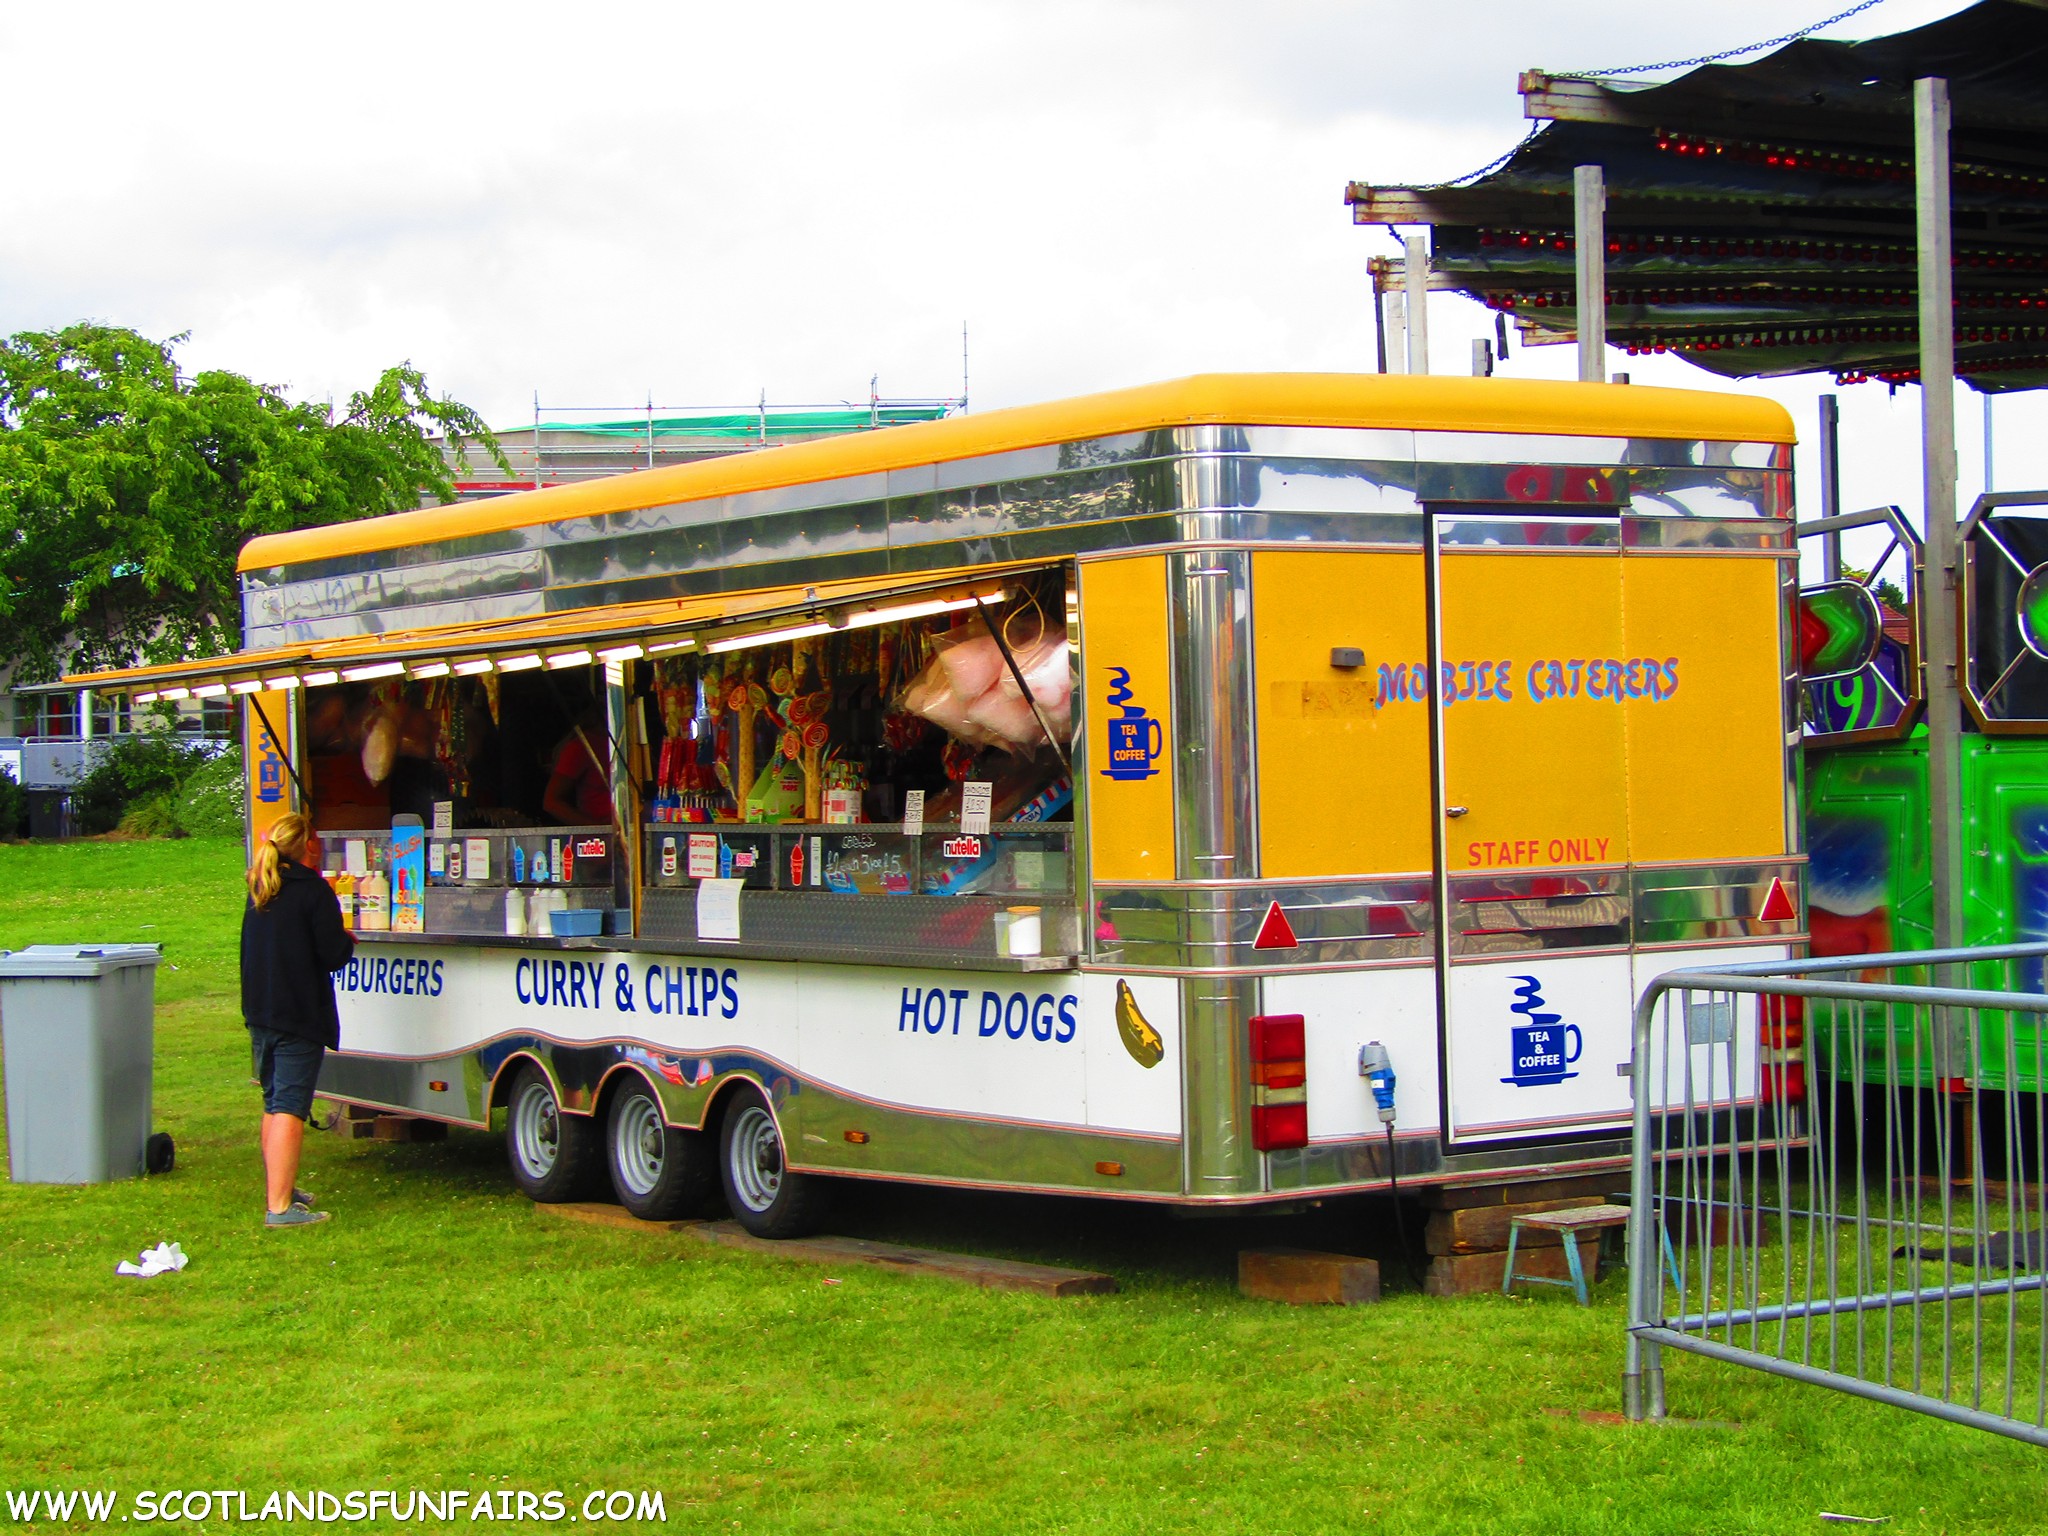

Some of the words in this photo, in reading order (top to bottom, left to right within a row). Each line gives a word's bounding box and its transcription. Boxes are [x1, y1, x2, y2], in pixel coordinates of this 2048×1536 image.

[1375, 660, 1512, 710] MOBILE
[1527, 657, 1679, 704] CATERERS
[1120, 724, 1138, 736] TEA
[1125, 737, 1134, 748] &
[1113, 749, 1146, 761] COFFEE
[578, 839, 605, 855] nutella
[945, 838, 980, 856] nutella
[1468, 840, 1540, 866] STAFF
[1548, 838, 1610, 863] ONLY
[332, 957, 444, 997] MBURGERS
[516, 957, 605, 1010] CURRY
[615, 962, 637, 1012] &
[645, 964, 740, 1019] CHIPS
[899, 987, 969, 1035] HOT
[979, 991, 1078, 1043] DOGS
[1528, 1031, 1550, 1043] TEA
[1534, 1043, 1544, 1054] &
[1519, 1054, 1560, 1067] COFFEE
